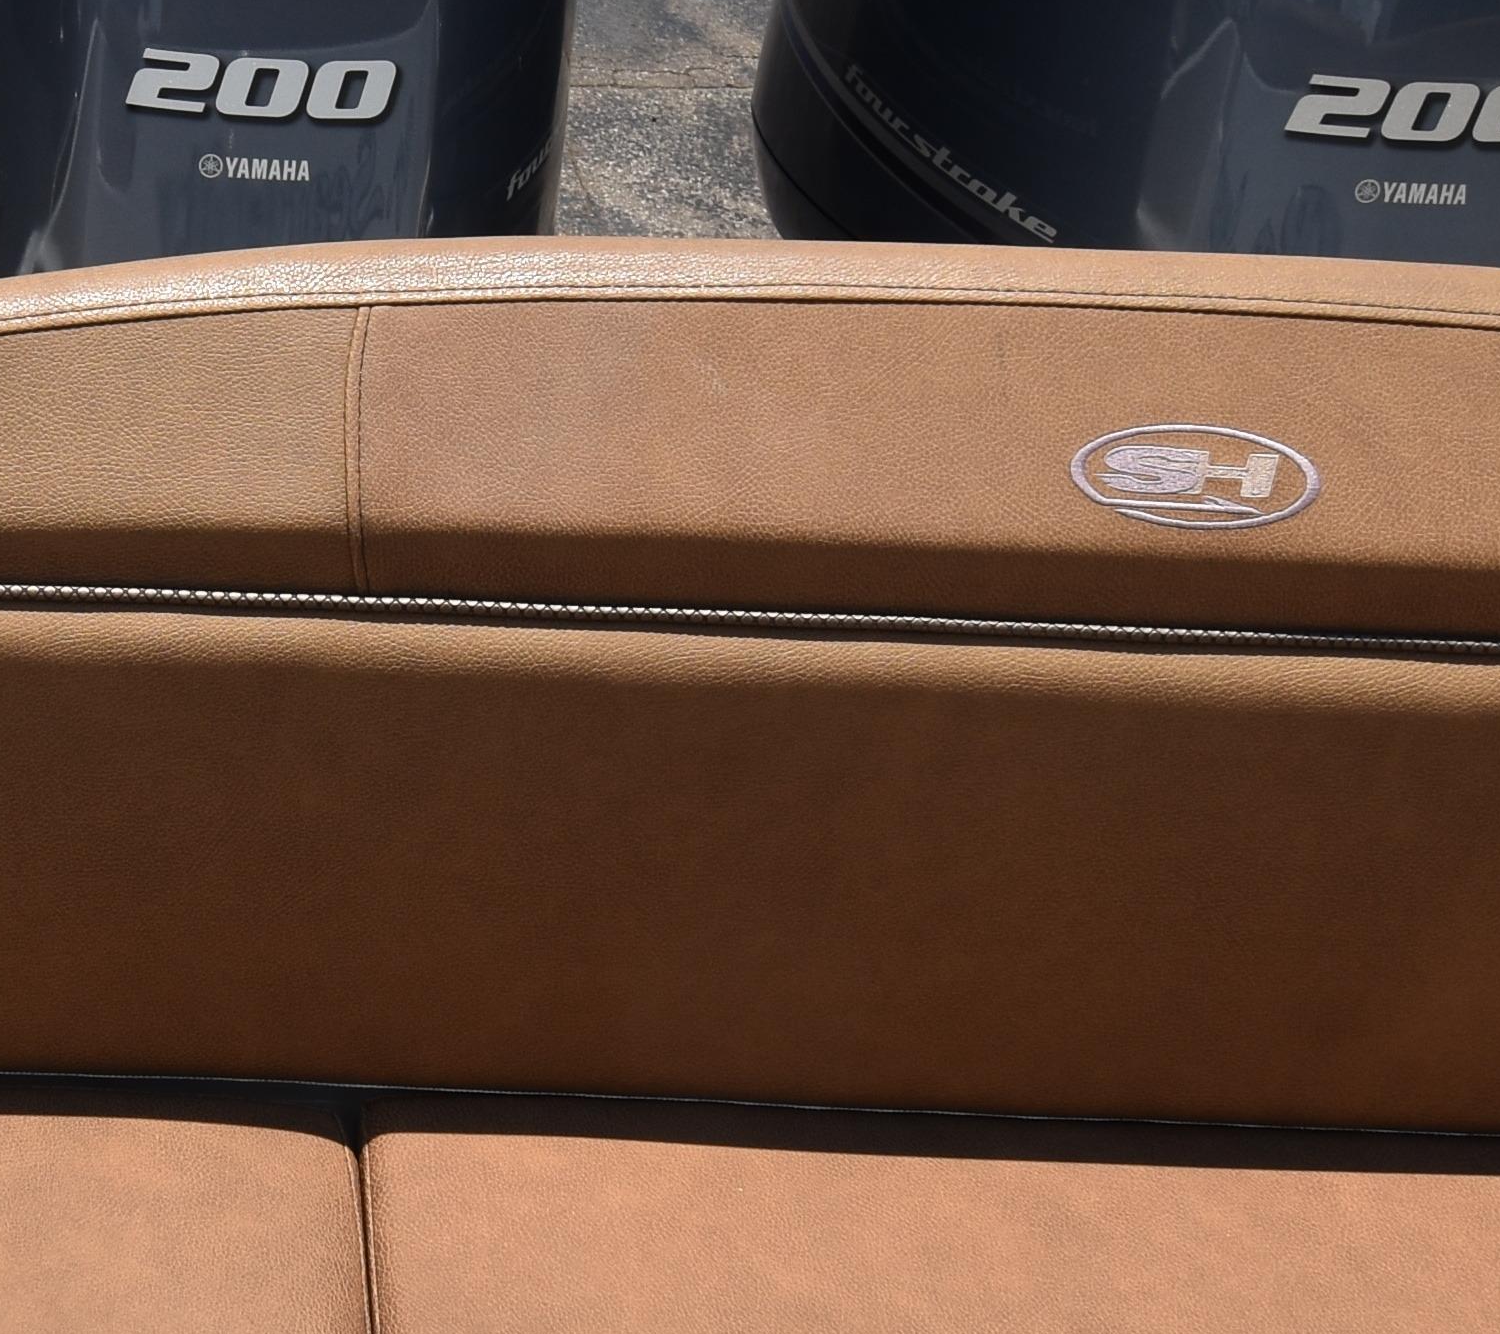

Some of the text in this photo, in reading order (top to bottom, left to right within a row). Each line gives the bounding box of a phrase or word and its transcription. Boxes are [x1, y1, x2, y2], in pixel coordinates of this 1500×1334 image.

[125, 47, 397, 120] 200
[225, 156, 310, 182] YAMAHA
[1382, 180, 1467, 205] YAMAHA
